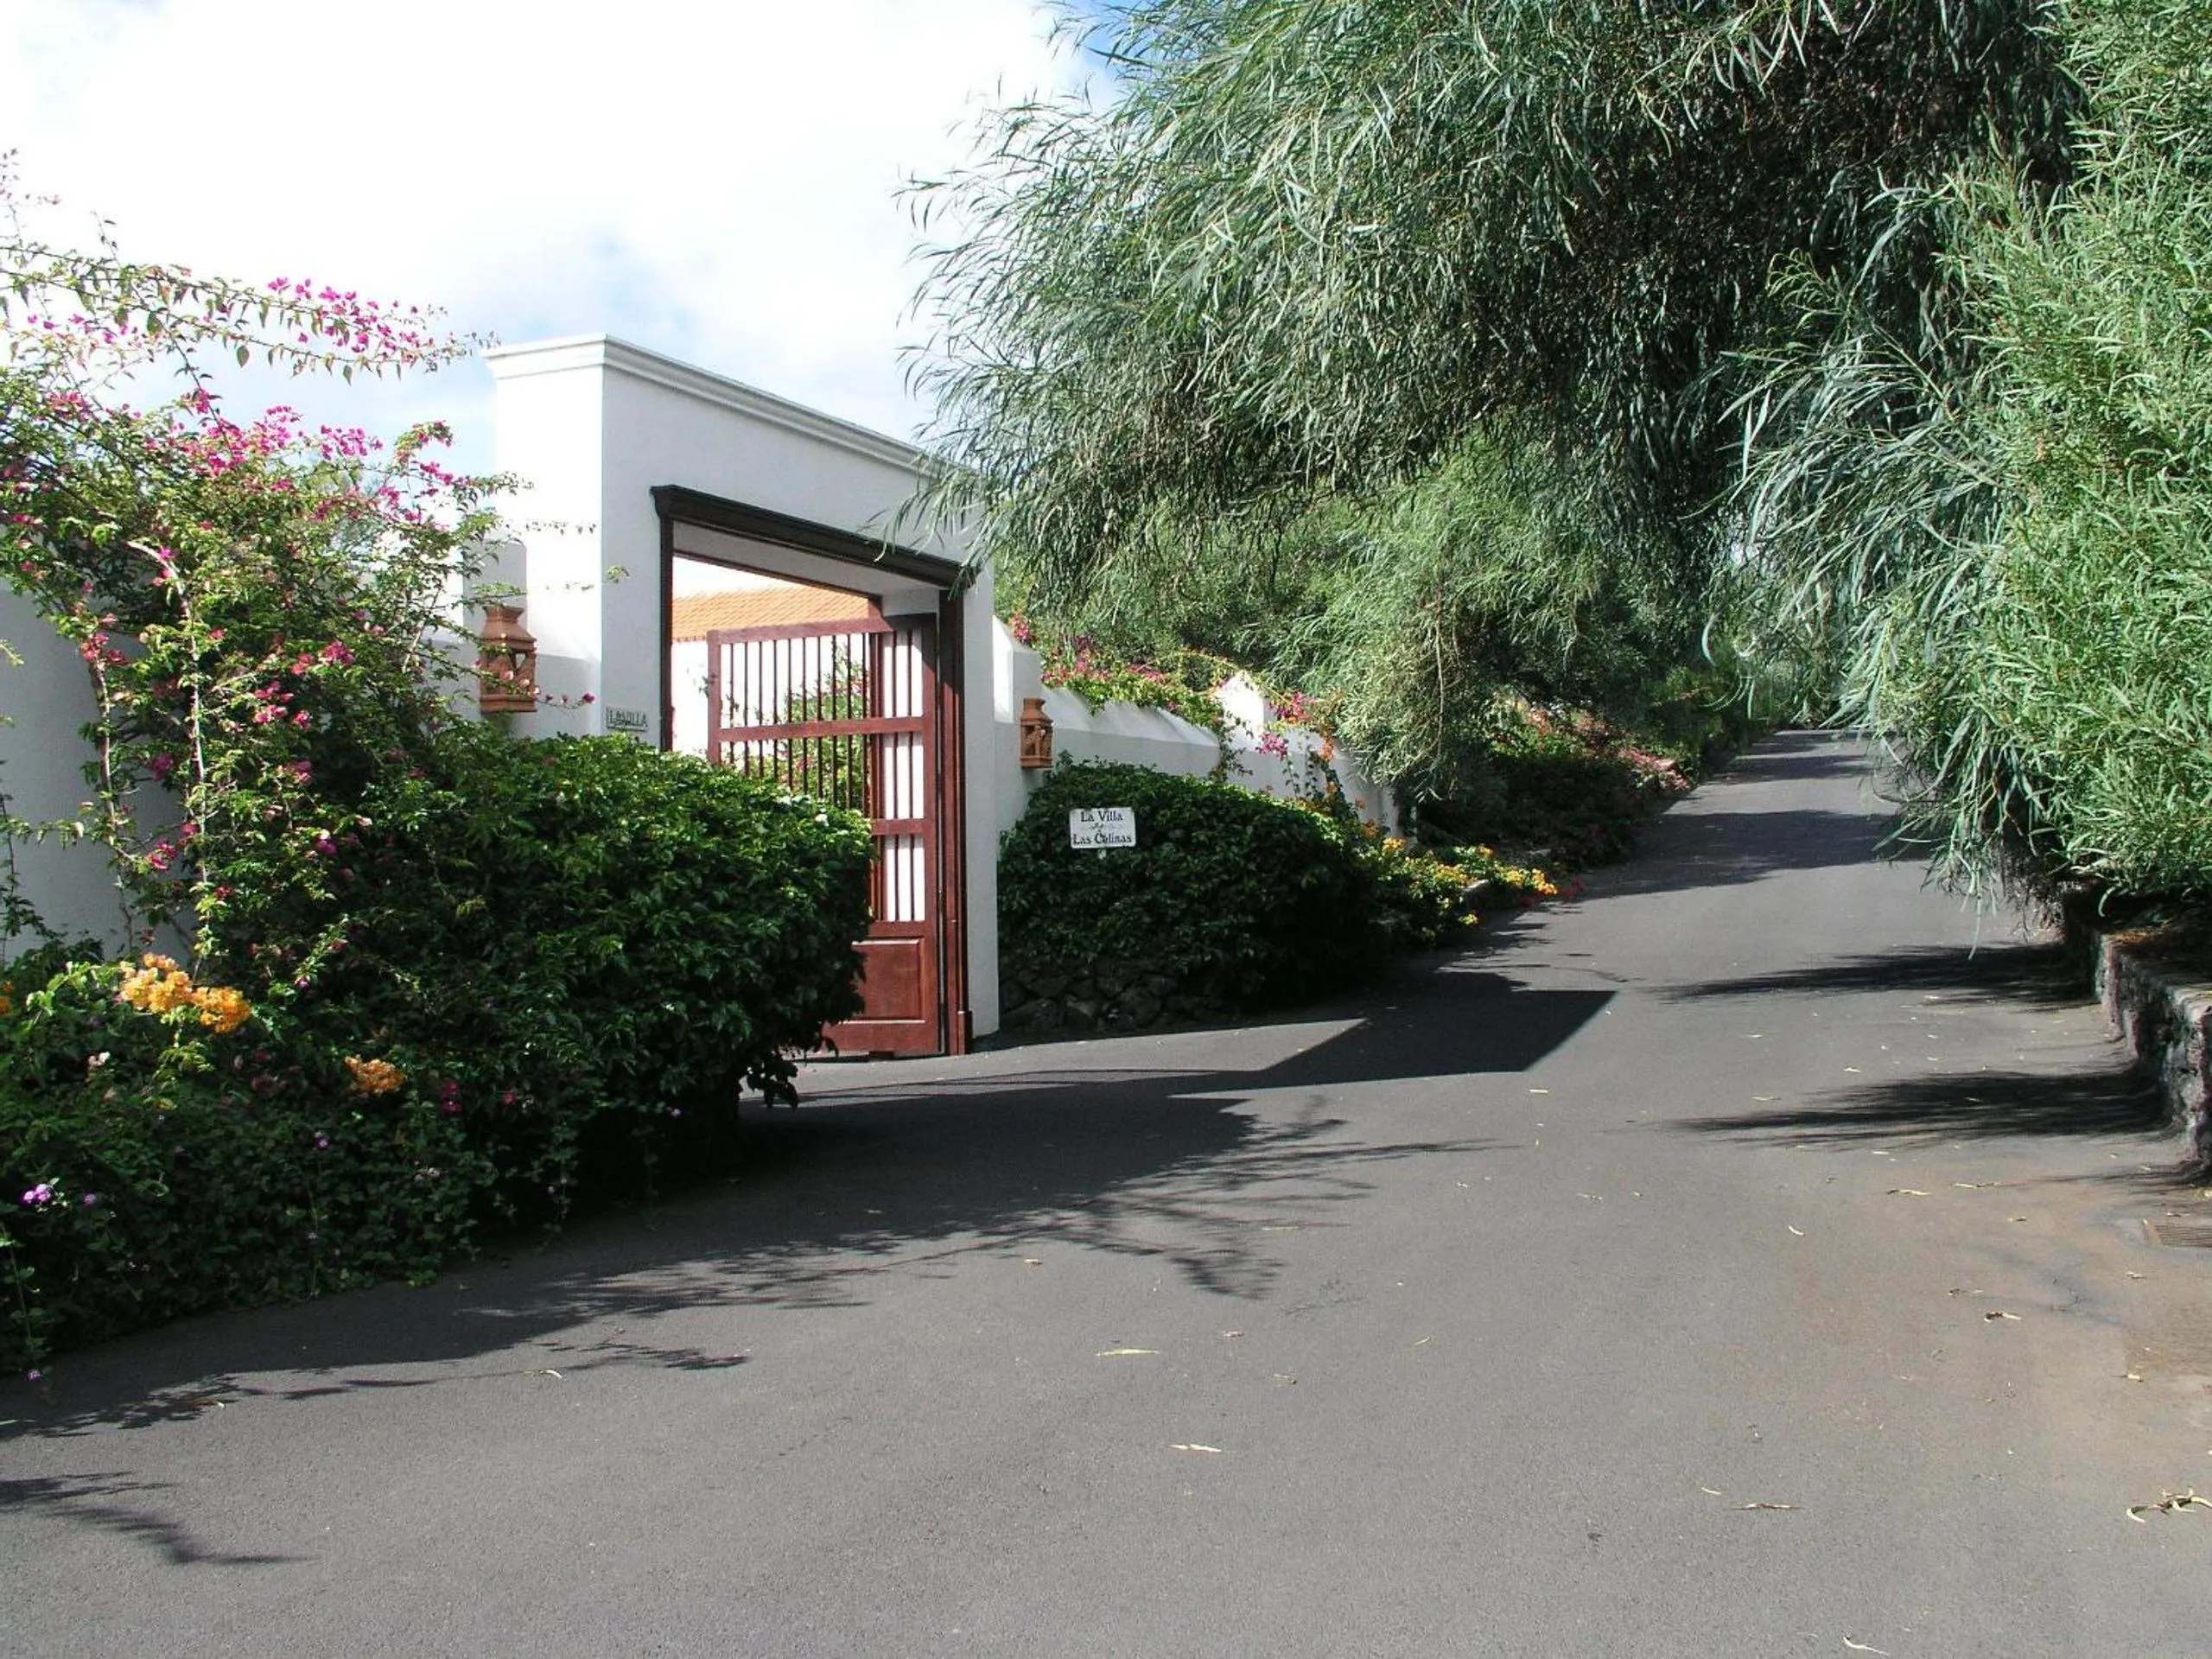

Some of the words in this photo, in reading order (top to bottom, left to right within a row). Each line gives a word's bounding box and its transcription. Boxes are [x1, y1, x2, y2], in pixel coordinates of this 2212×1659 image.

[1081, 811, 1095, 822] La
[1098, 810, 1123, 822] Villa
[1073, 834, 1092, 845] Las
